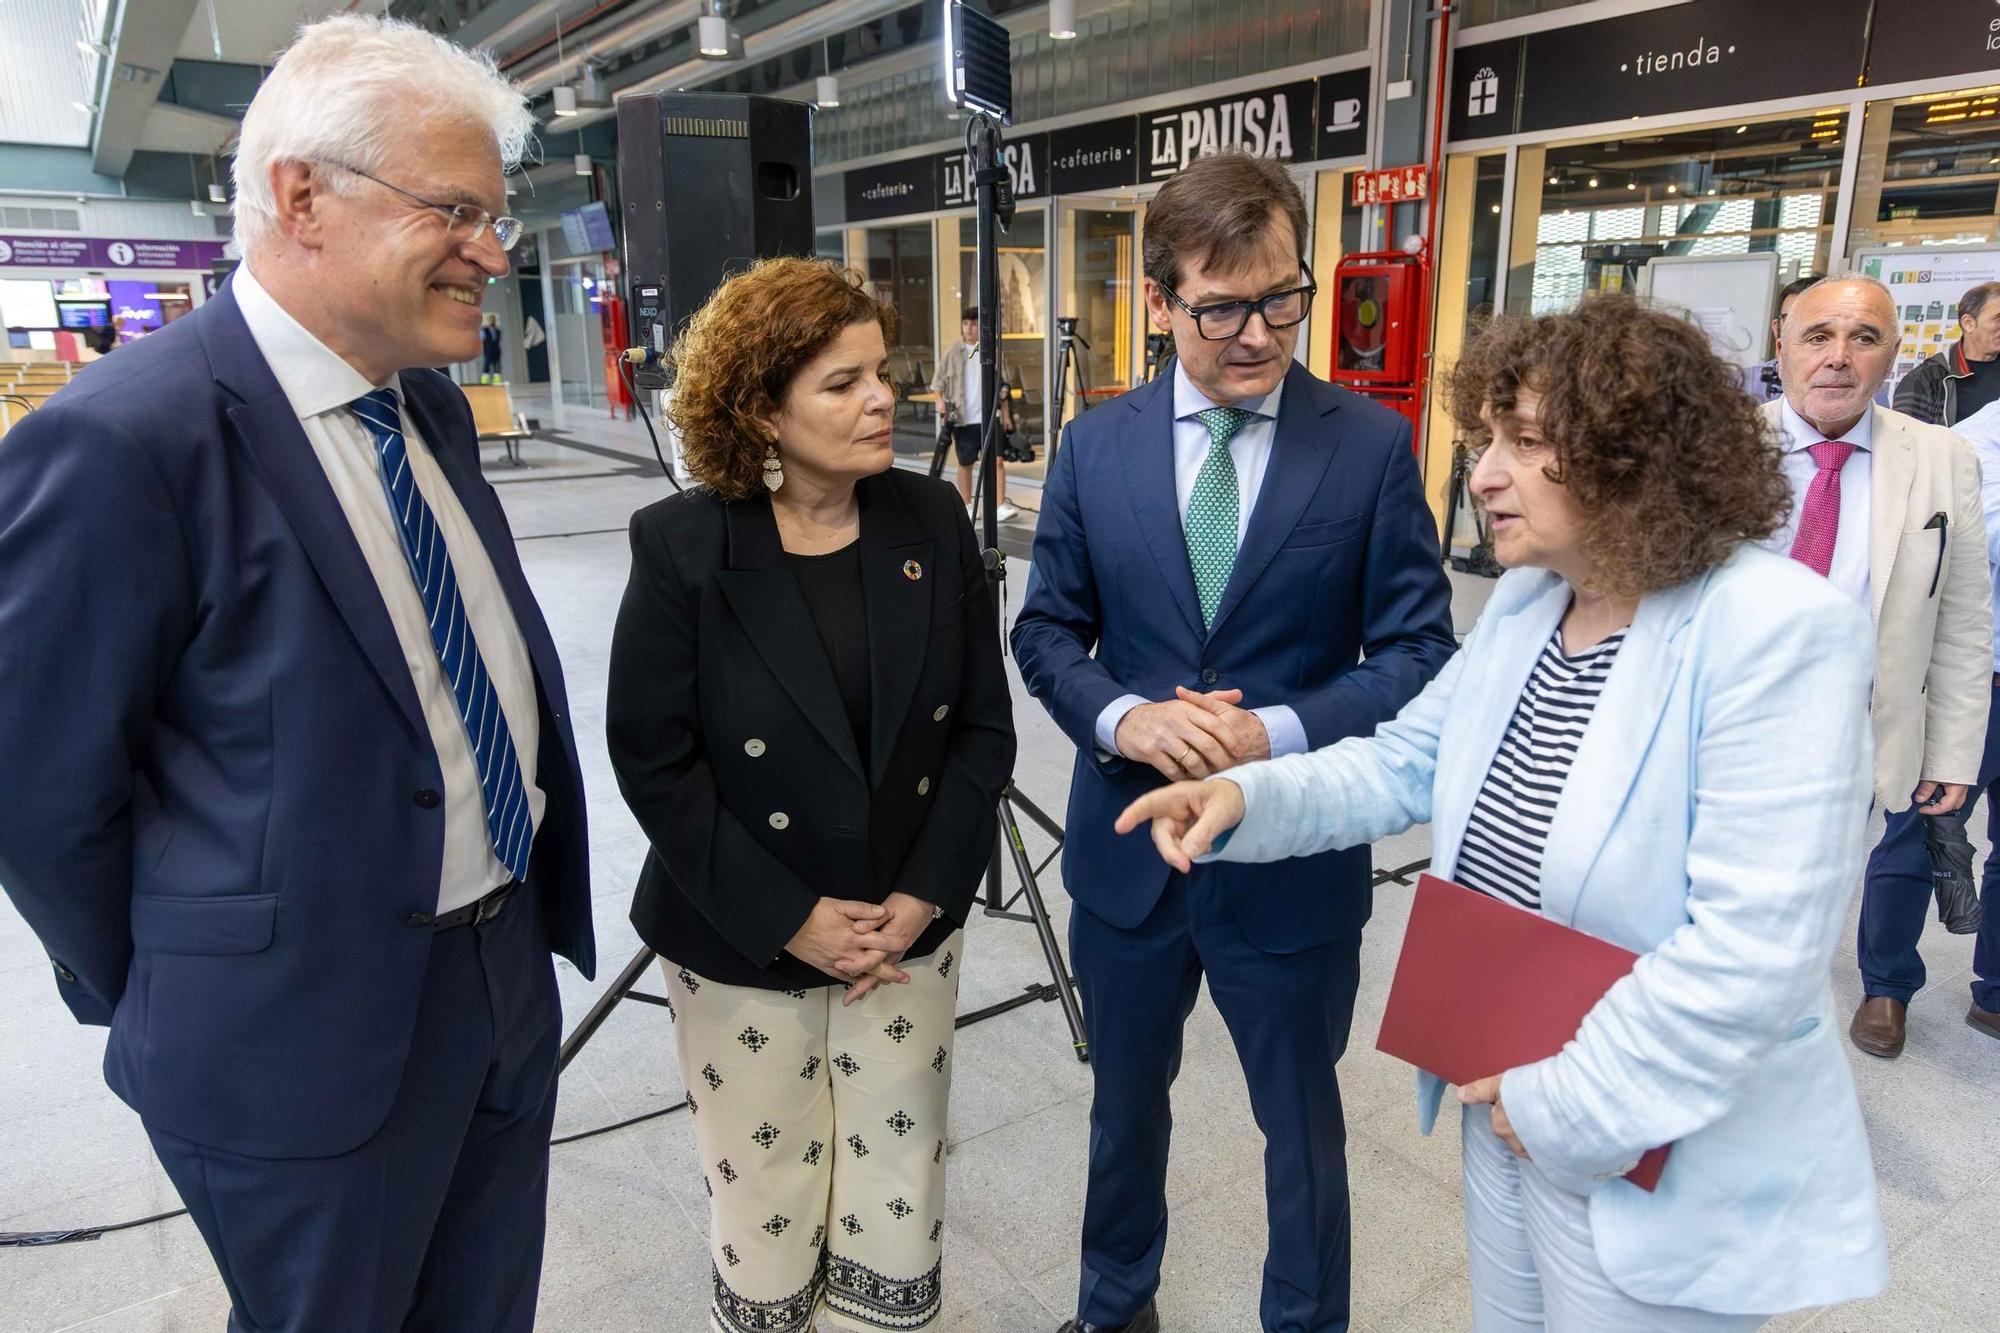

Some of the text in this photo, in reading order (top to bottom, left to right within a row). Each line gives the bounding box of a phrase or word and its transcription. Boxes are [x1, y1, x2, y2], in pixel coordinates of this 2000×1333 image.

[1636, 37, 1719, 75] tienda
[1151, 93, 1293, 171] LA PAUSA
[945, 165, 962, 195] LA
